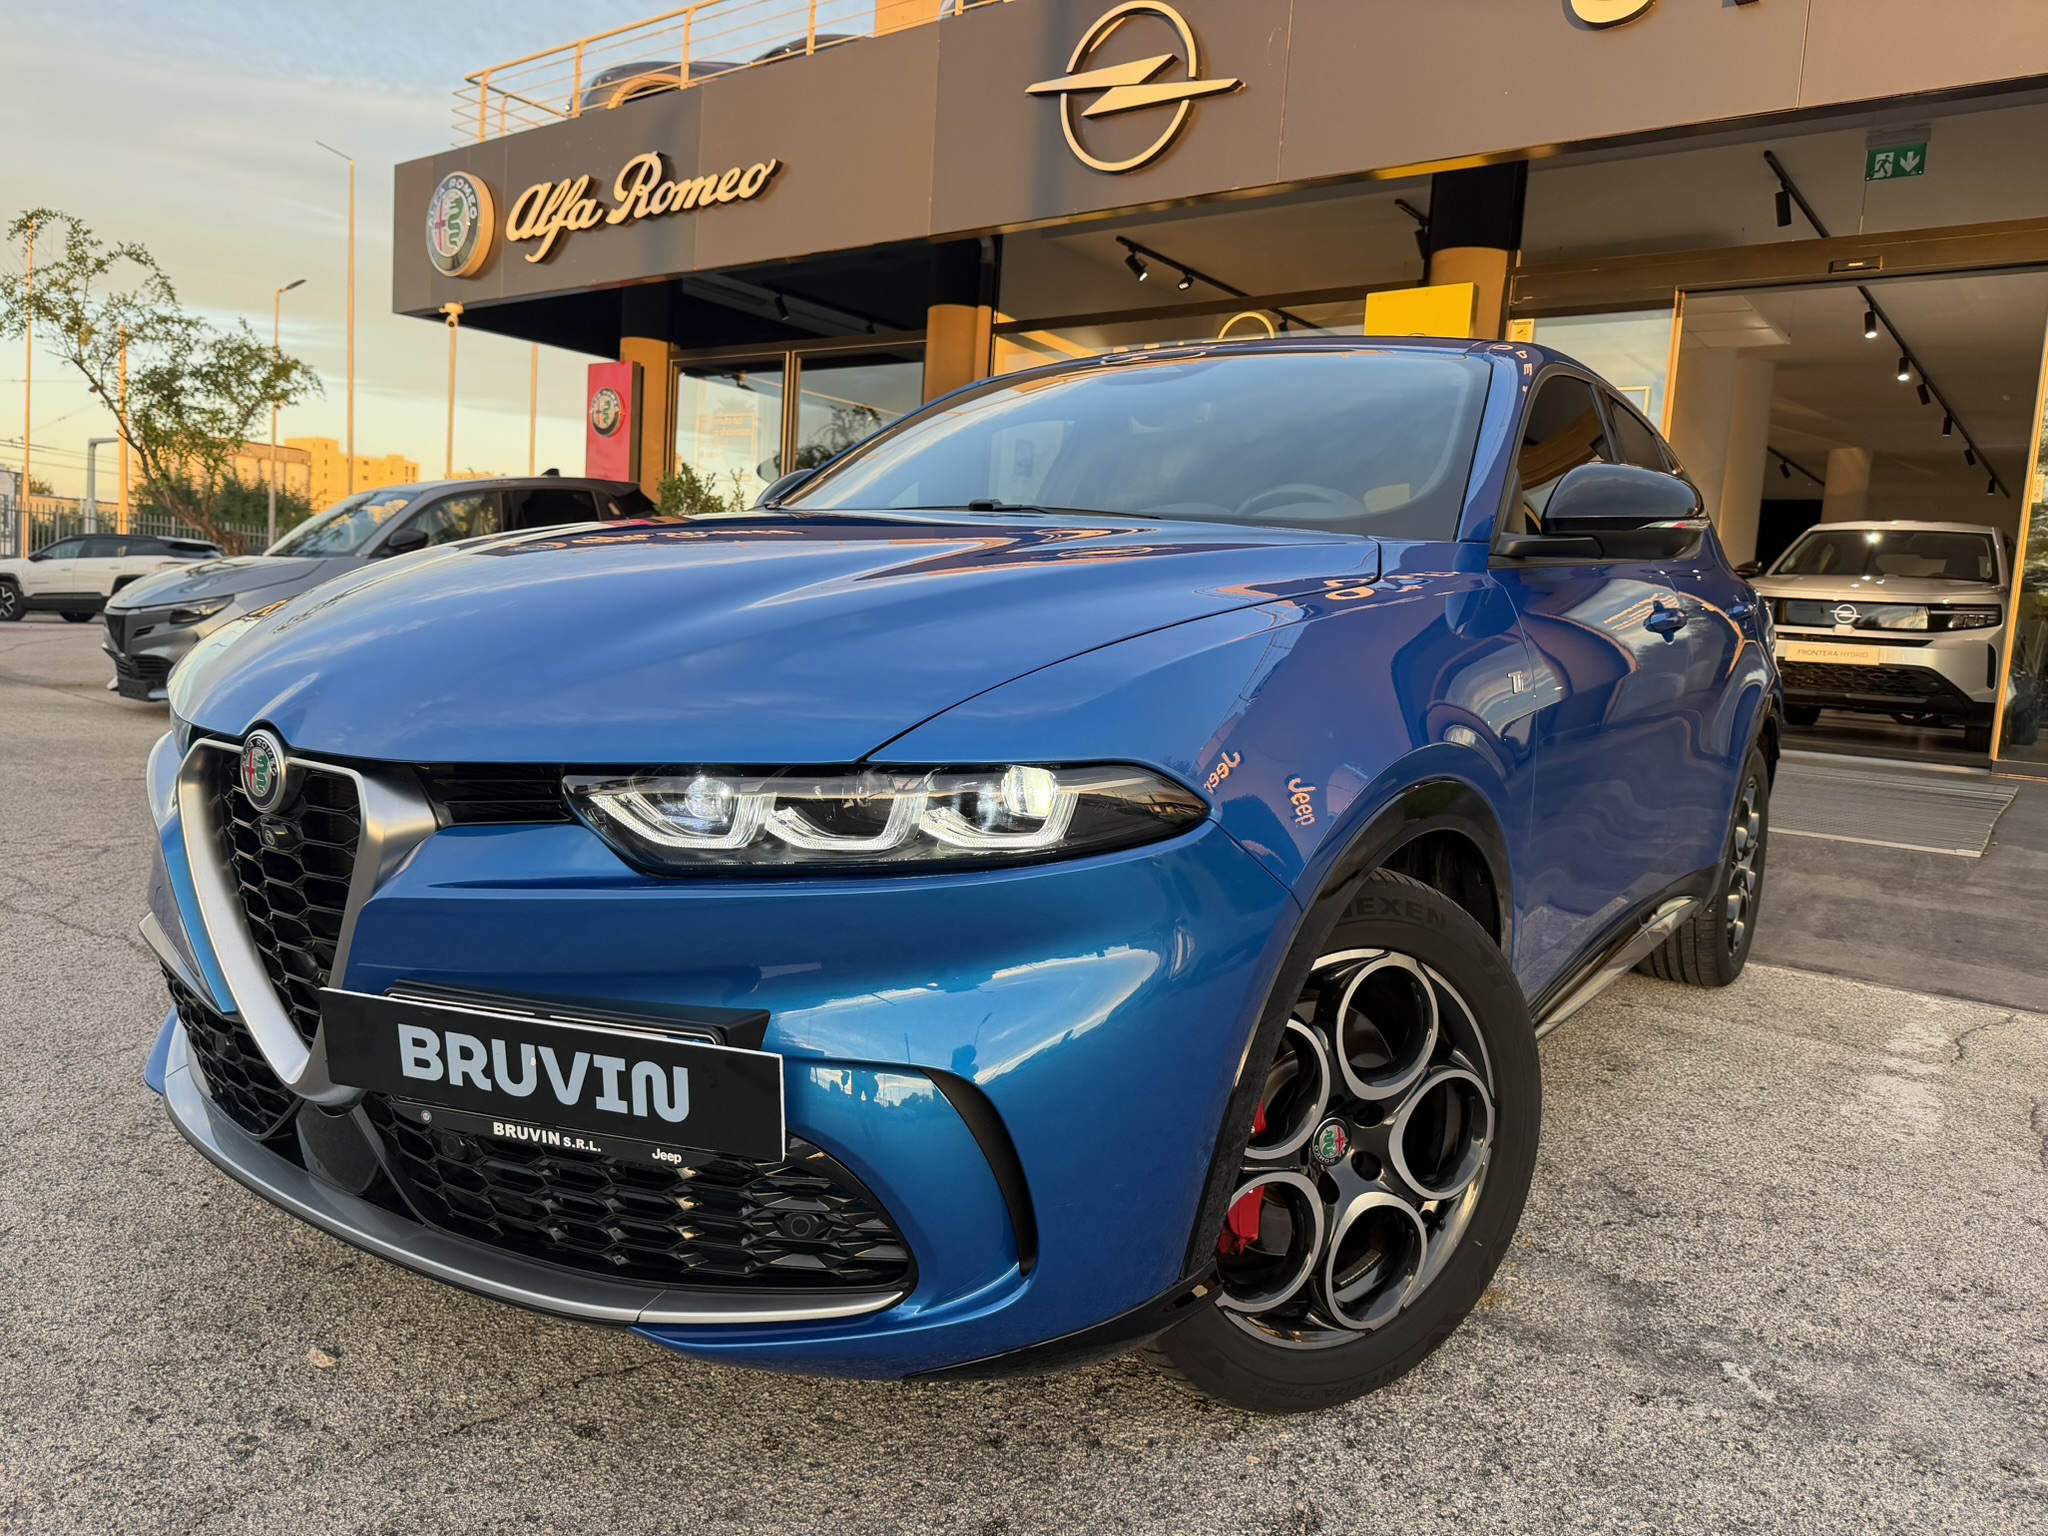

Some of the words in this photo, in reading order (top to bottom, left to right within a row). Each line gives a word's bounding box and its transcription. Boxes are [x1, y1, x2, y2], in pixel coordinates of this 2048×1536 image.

[448, 178, 478, 220] ROMEO
[505, 174, 604, 263] Alfa
[605, 151, 777, 225] Romeo
[1797, 648, 1839, 658] FRONTERA
[1840, 649, 1869, 659] HYBRID
[256, 739, 278, 777] ROMEO
[1288, 777, 1317, 826] Jeep
[397, 1022, 691, 1123] BRUVIN
[492, 1121, 561, 1146] BRUVIN
[562, 1136, 602, 1152] S.R.L.
[652, 1148, 682, 1164] Jeep
